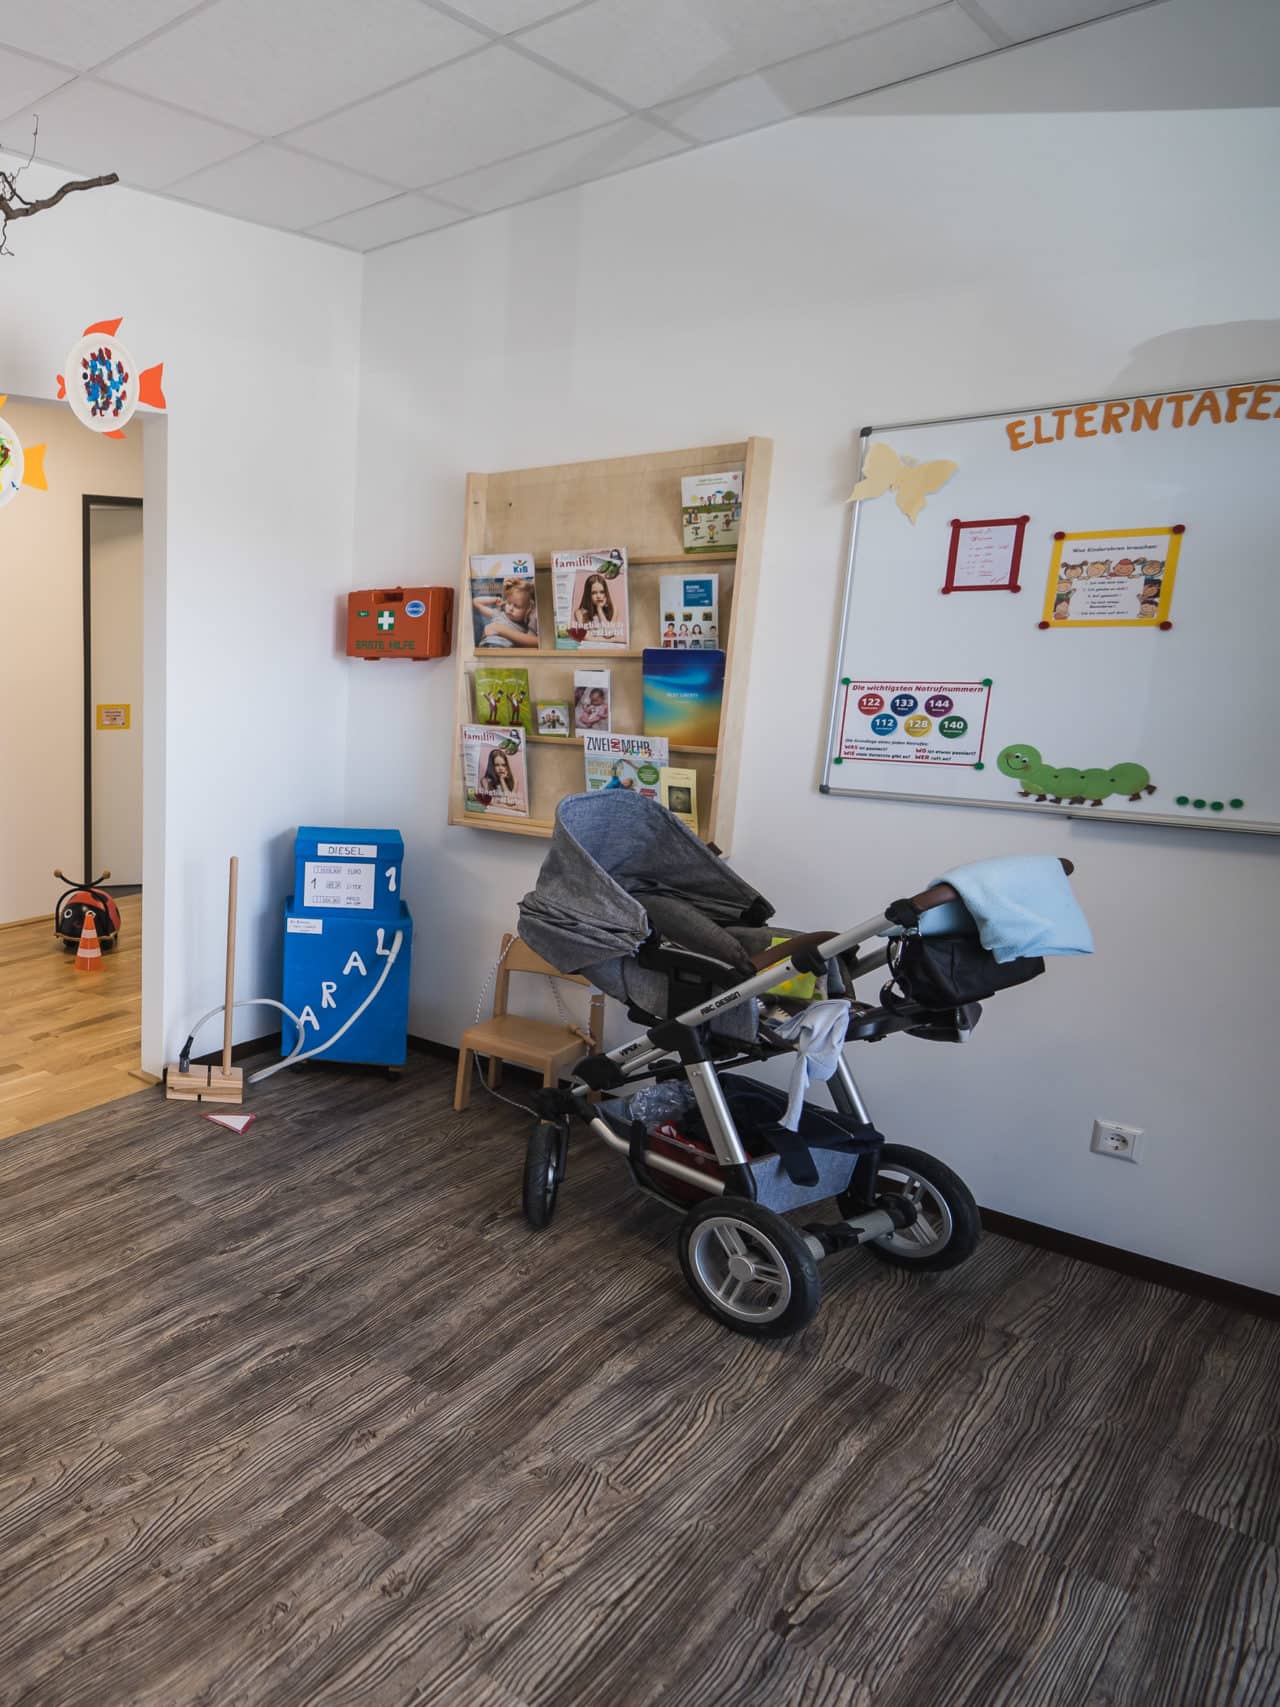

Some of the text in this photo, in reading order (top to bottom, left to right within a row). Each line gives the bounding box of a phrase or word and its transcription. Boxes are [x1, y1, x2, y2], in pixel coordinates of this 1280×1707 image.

[1005, 384, 1280, 452] ELTERNTAFE
[852, 684, 984, 693] Die wichtigsten Notrufnummern
[861, 697, 881, 707] 122
[894, 698, 914, 708] 133
[928, 699, 950, 709] 144
[874, 718, 895, 727] 112
[908, 719, 929, 729] 128
[943, 720, 964, 730] 140
[586, 736, 610, 752] ZWEI
[621, 739, 651, 754] MEHR
[327, 845, 365, 856] DIESEL
[384, 865, 397, 893] 1
